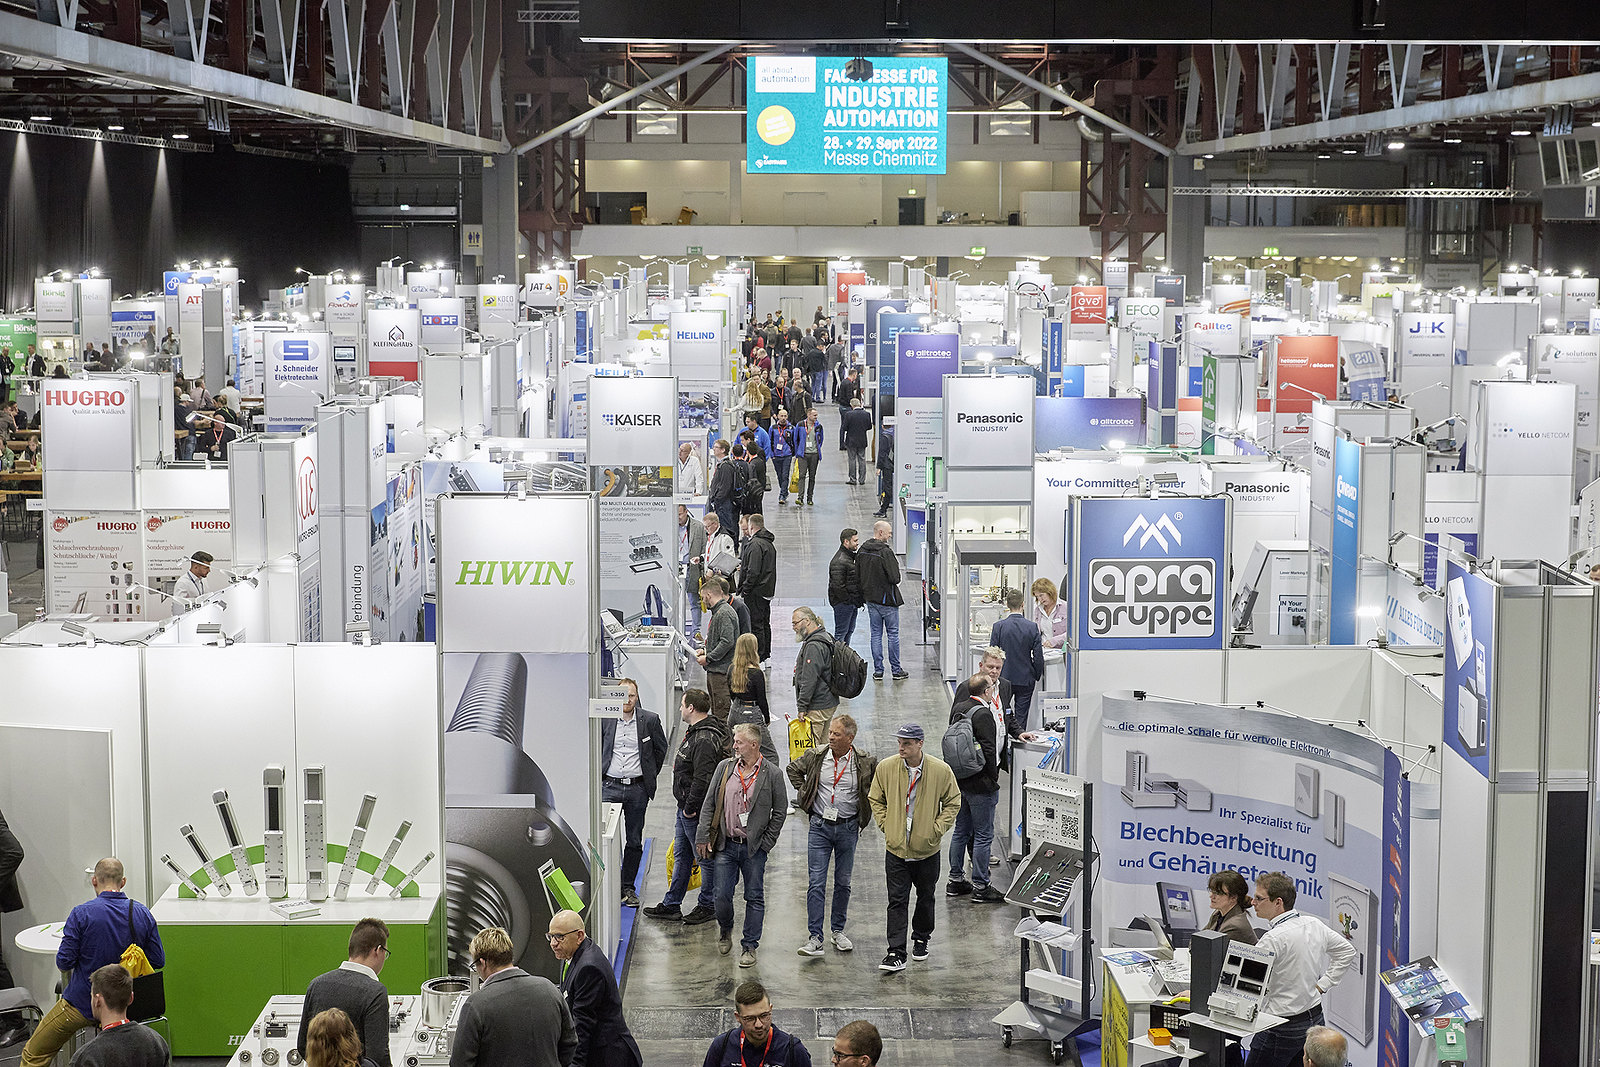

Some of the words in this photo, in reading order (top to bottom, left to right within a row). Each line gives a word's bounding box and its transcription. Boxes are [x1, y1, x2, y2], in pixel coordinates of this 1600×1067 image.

[824, 68, 908, 84] FACESSE
[910, 66, 938, 84] FÜR
[824, 86, 938, 108] INDUSTRIE
[823, 109, 938, 128] AUTOMATION
[823, 136, 844, 150] 28.
[856, 136, 874, 150] 29.
[876, 136, 905, 152] Sept
[907, 136, 938, 150] 2022
[824, 150, 869, 166] Messe
[873, 150, 938, 166] Chemnitz
[42, 289, 66, 298] Börsig
[529, 282, 544, 291] JAT
[423, 316, 457, 324] HOPF
[677, 331, 715, 340] HEILIND
[45, 390, 125, 406] HUGRO
[615, 414, 661, 426] KAISER
[957, 412, 1024, 424] Panasonic
[1046, 478, 1072, 488] Your
[1225, 482, 1290, 493] Panasonic
[97, 522, 137, 531] HUGRO
[191, 521, 230, 530] HUGRO
[455, 561, 574, 585] HIWIN
[1092, 564, 1212, 603] apra
[1091, 605, 1212, 635] gruppe
[1399, 606, 1413, 628] ALLES
[1413, 613, 1423, 634] FÜR
[1423, 621, 1432, 640] DIE
[794, 740, 813, 748] PILZ
[1118, 722, 1135, 731] die
[1138, 722, 1184, 736] optimale
[1187, 726, 1221, 738] Schale
[1224, 729, 1240, 740] für
[1242, 733, 1287, 748] wertvolle
[1290, 740, 1331, 758] Elektronik
[1219, 807, 1236, 819] Ihr
[1240, 810, 1293, 831] Spezialist
[1296, 821, 1312, 834] für
[1120, 821, 1317, 874] Blechbearbeitung
[1119, 857, 1144, 868] und
